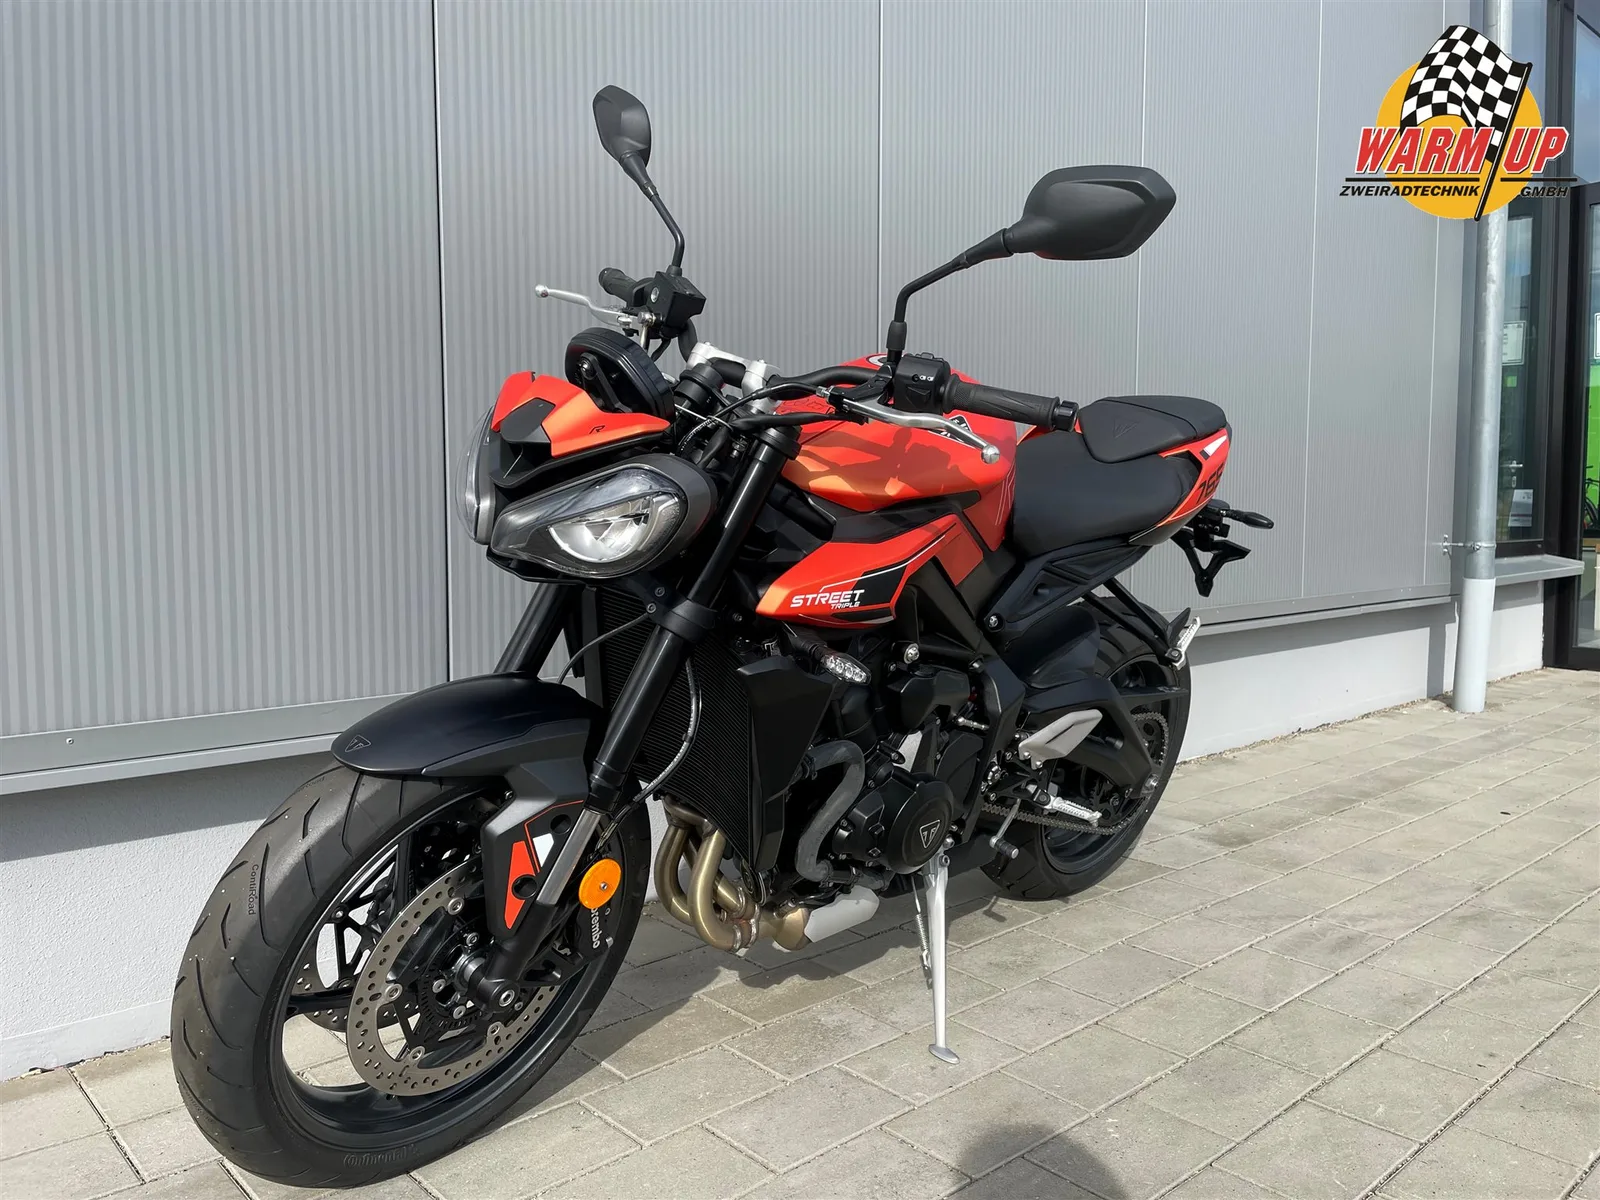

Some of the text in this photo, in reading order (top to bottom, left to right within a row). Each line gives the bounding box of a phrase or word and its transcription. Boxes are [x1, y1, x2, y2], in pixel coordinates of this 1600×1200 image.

[790, 589, 865, 607] STREET
[830, 601, 860, 610] TRIPLE
[247, 864, 259, 915] ContiRoad
